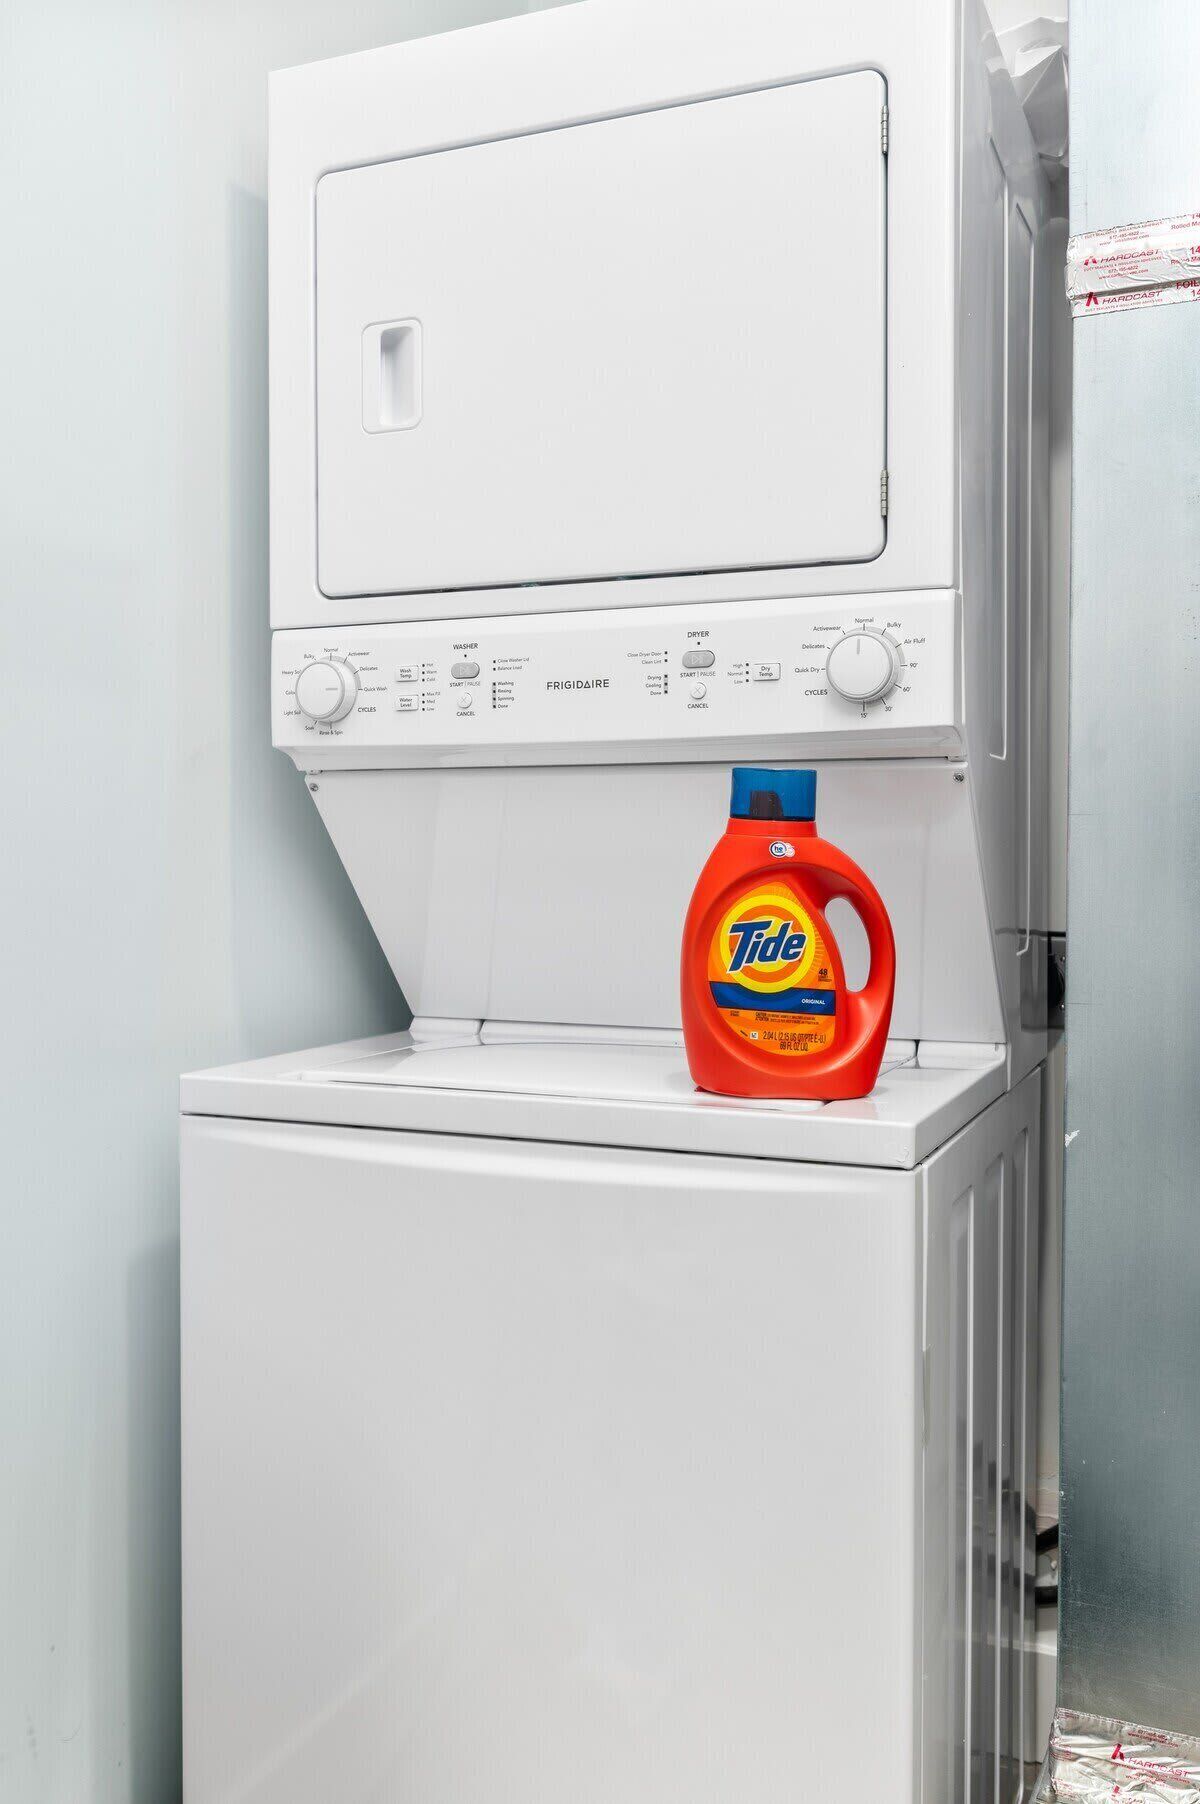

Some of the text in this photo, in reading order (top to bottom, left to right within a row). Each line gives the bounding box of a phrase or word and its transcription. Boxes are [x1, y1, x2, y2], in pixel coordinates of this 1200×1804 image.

[1100, 249, 1159, 263] HARDCAST
[1102, 290, 1162, 304] HARDCAST
[547, 679, 609, 690] FRIGIDAIRE
[726, 919, 807, 974] Tide
[818, 968, 828, 976] 48
[763, 1031, 773, 1040] 2.04
[778, 1032, 789, 1041] (2.15
[787, 1042, 792, 1050] FL
[794, 1043, 799, 1051] OZ
[1128, 1758, 1190, 1777] HARDCAST
